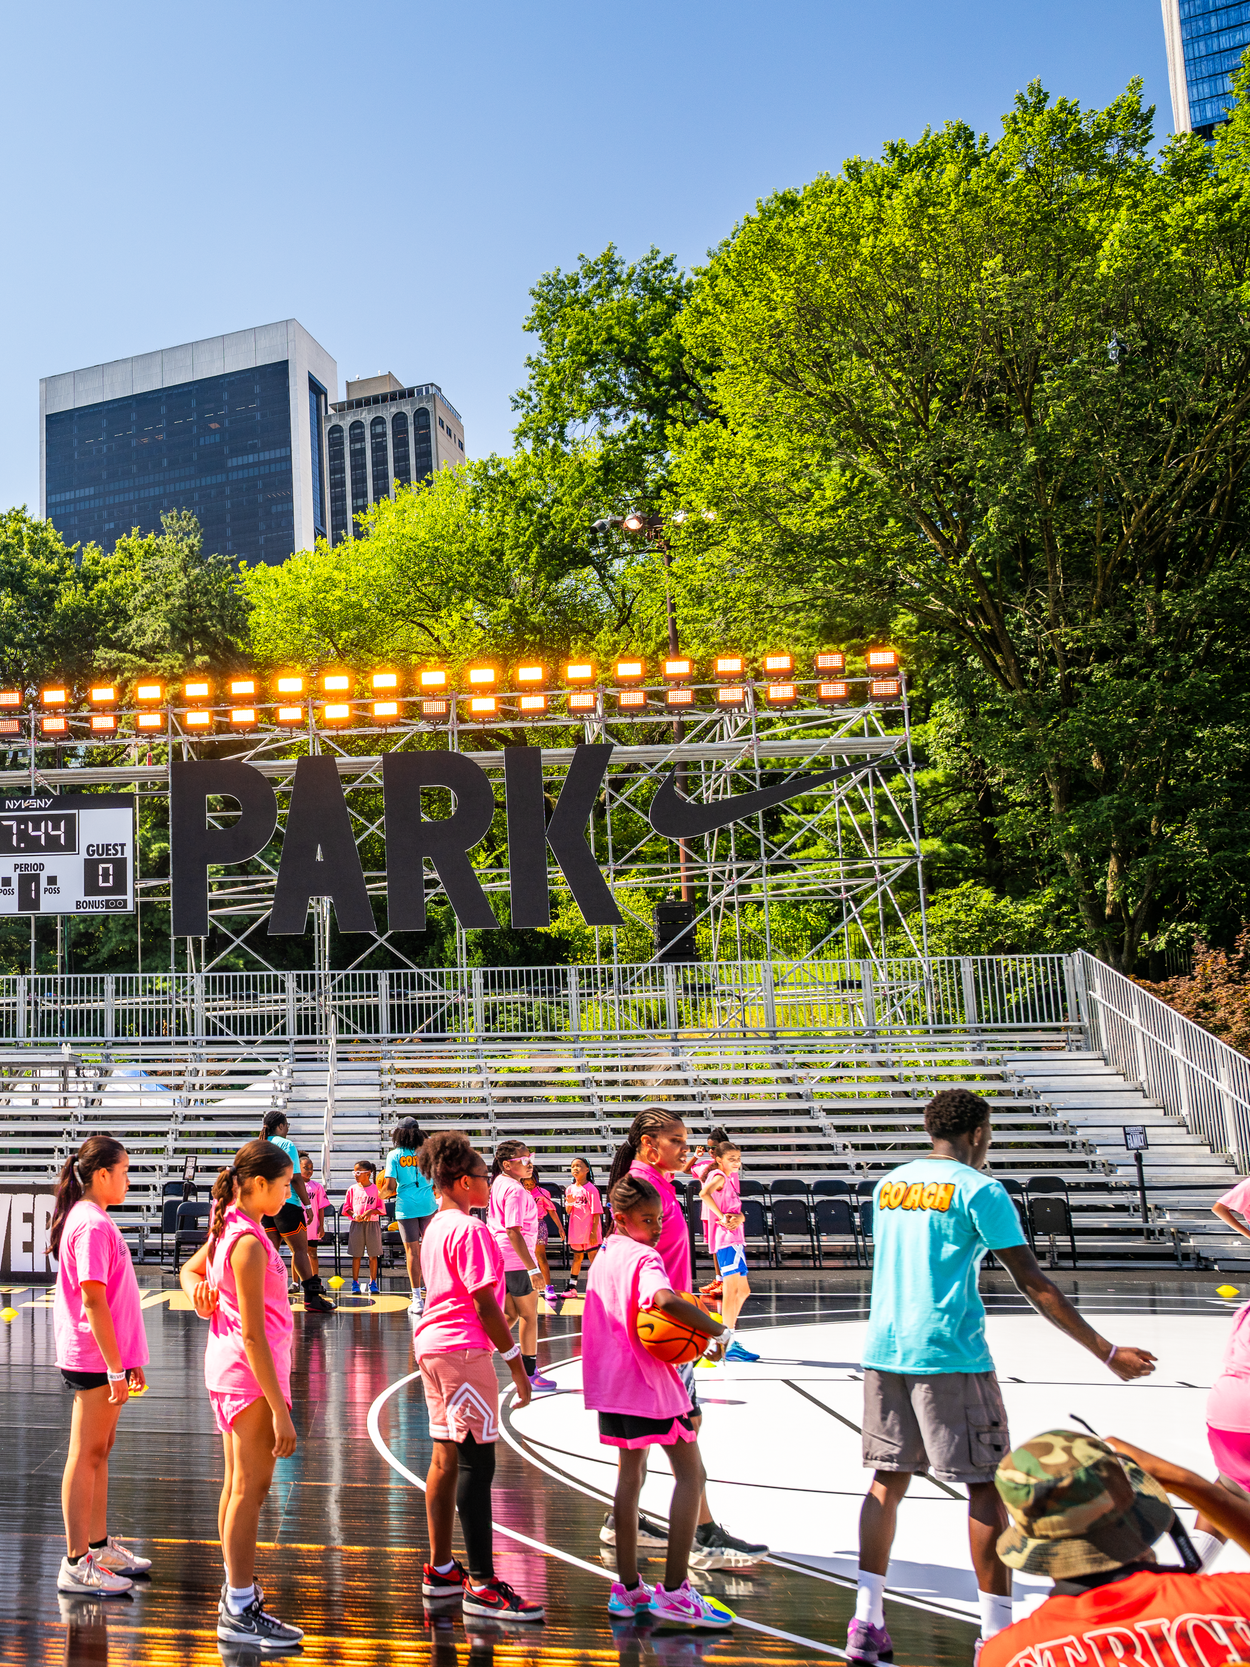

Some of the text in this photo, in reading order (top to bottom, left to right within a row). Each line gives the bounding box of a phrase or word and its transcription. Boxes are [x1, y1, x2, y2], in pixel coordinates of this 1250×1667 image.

[1, 819, 65, 847] 7:44
[170, 743, 626, 936] PARK
[86, 843, 127, 857] GUEST
[13, 863, 45, 872] PERIOD
[98, 863, 113, 887] 0
[31, 881, 36, 899] 1
[43, 886, 61, 895] POSS
[75, 899, 105, 910] BONUS
[879, 1181, 956, 1213] COACH
